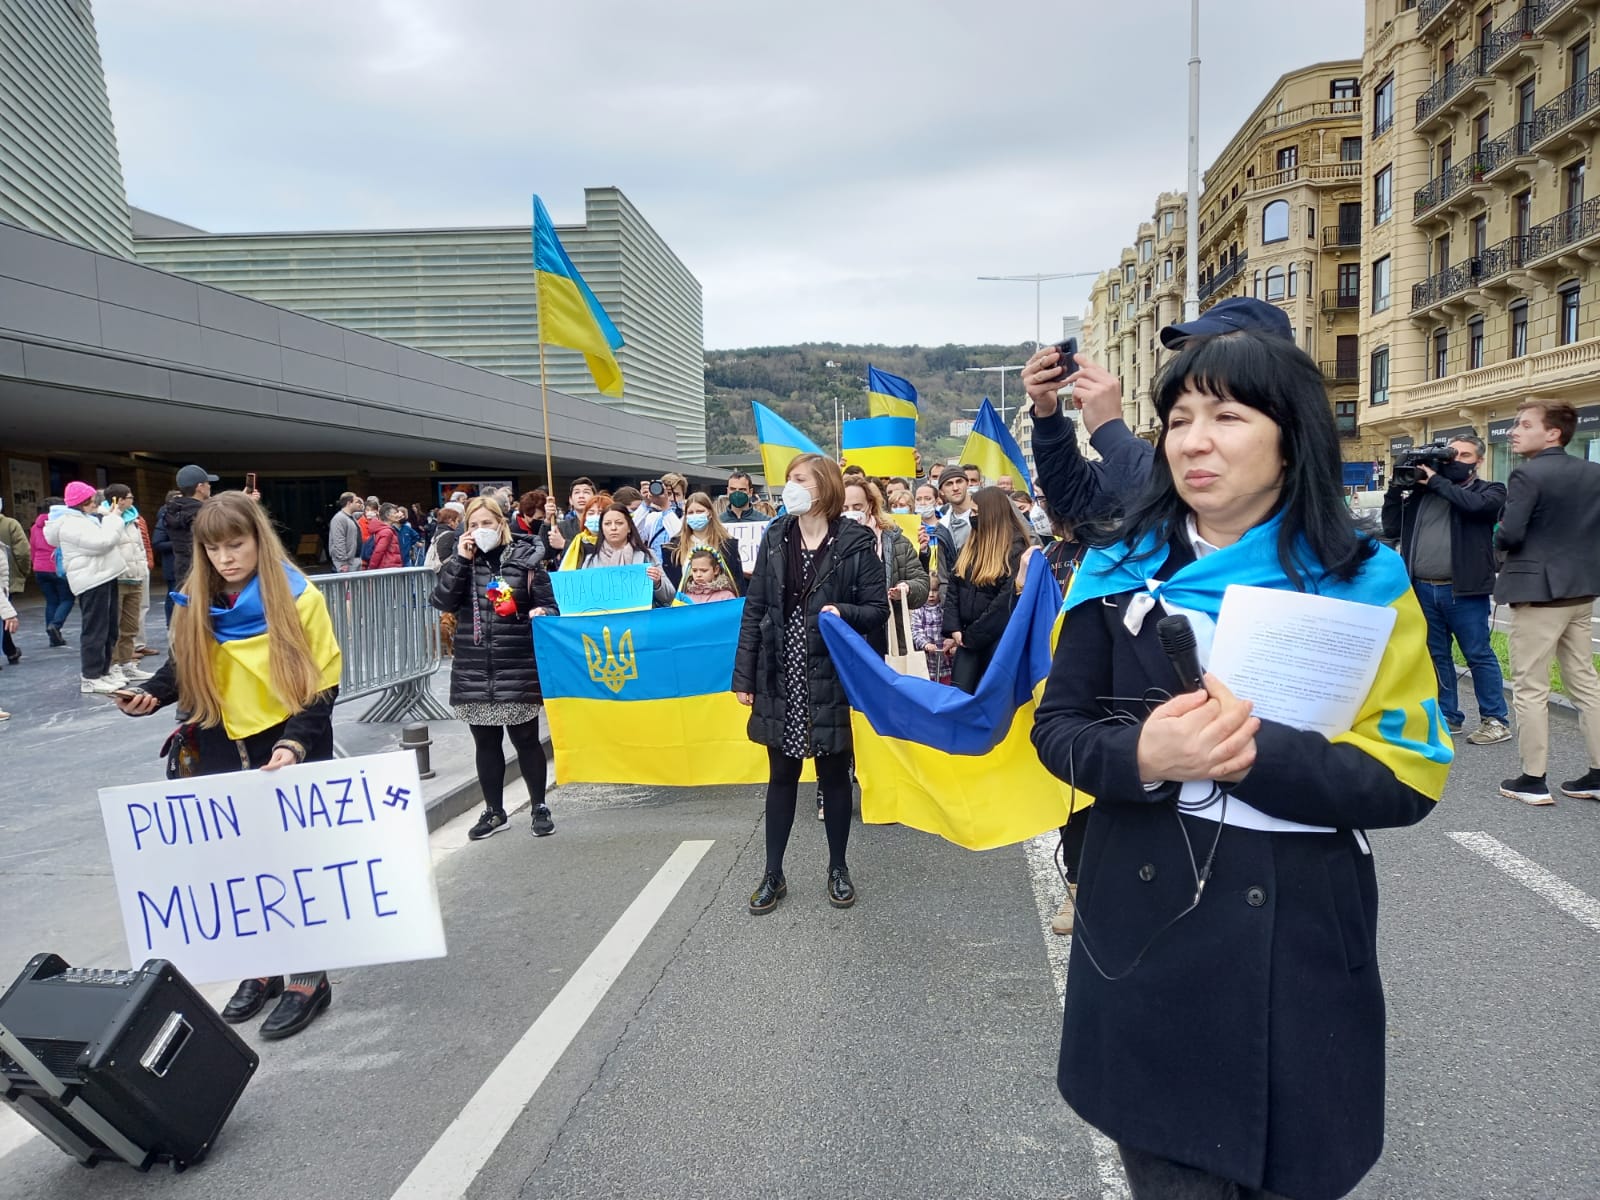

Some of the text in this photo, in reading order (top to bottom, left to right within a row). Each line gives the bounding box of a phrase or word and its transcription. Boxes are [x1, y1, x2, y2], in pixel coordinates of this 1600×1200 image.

[127, 770, 376, 850] PUTIN NAZI
[137, 858, 397, 950] MUERETE
